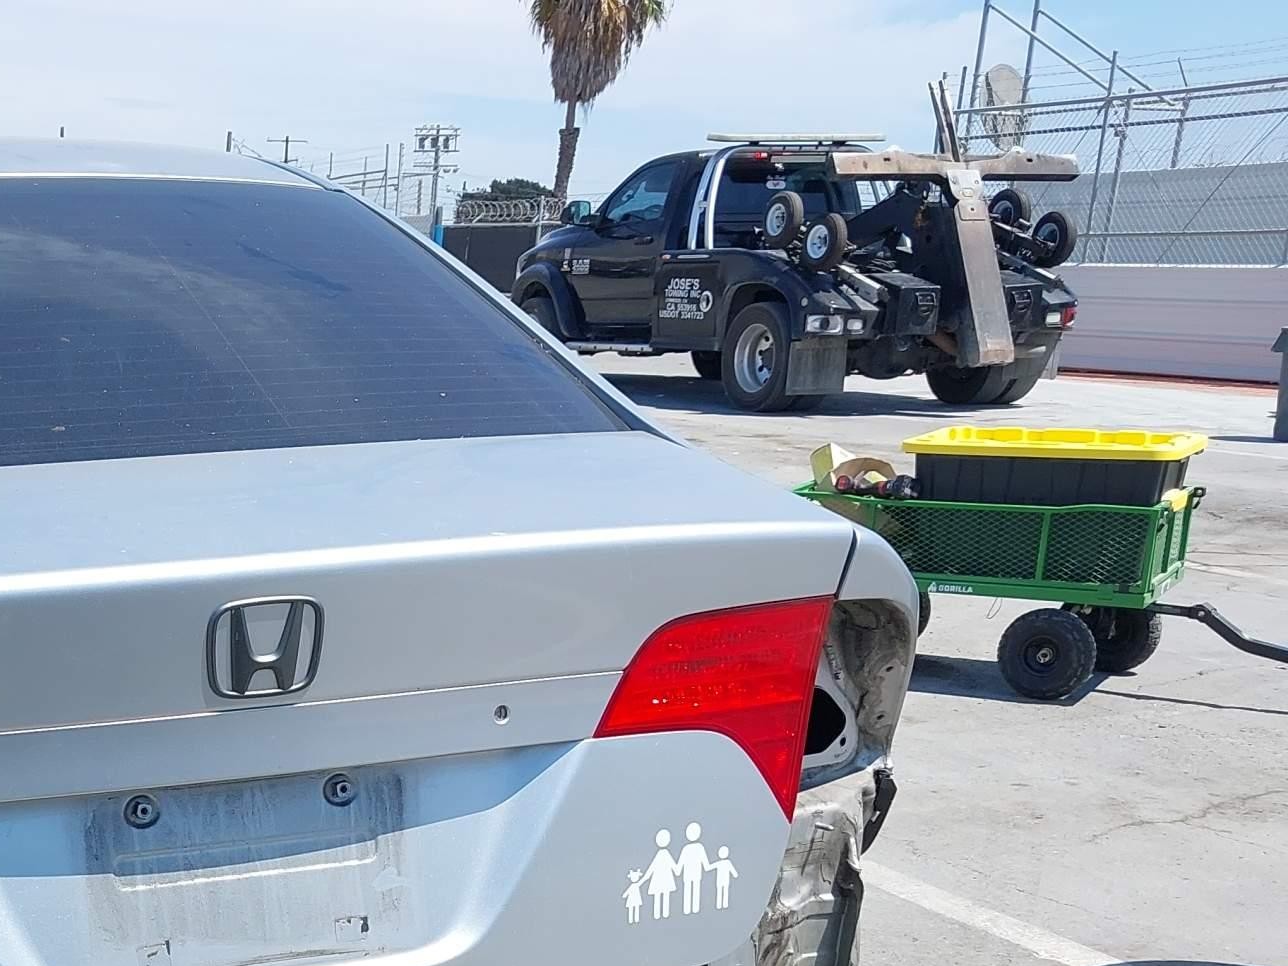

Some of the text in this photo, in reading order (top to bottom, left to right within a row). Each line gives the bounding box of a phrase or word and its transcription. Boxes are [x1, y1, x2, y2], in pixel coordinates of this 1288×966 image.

[667, 278, 700, 290] JOSE'S
[664, 289, 702, 299] TOWING INC
[659, 310, 679, 319] USDOT
[938, 584, 973, 593] GORILLA
